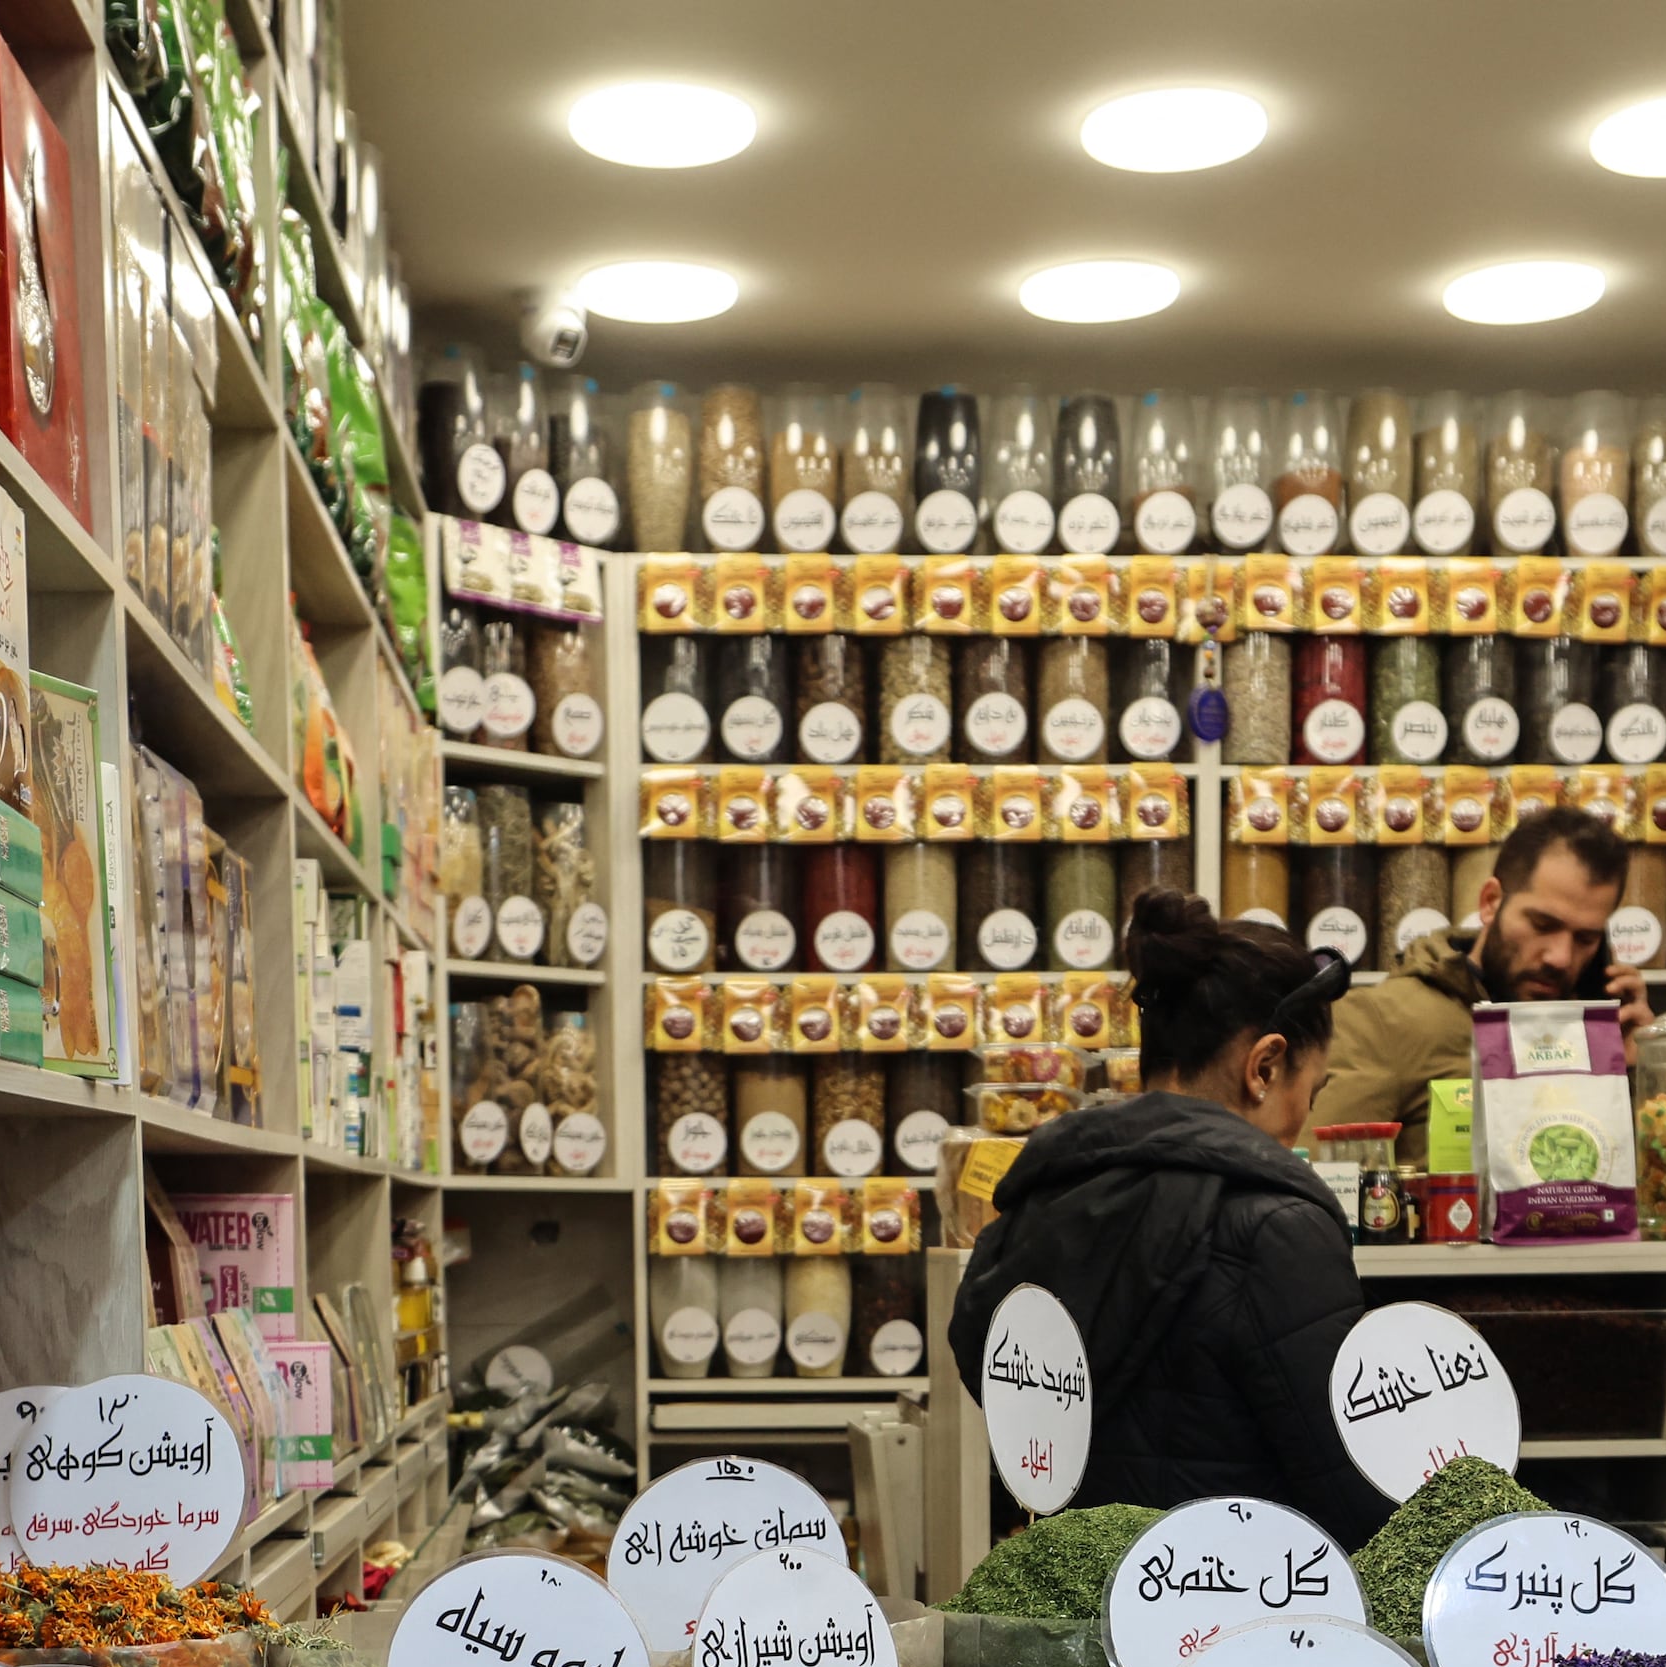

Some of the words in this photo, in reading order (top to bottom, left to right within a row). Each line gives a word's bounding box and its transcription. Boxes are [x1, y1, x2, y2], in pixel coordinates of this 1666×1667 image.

[988, 1327, 1041, 1391] خشک
[1043, 1356, 1086, 1412] شوید
[1426, 1343, 1488, 1393] نعنا
[1343, 1357, 1432, 1424] خشک
[26, 1424, 123, 1482] کوهی
[129, 1417, 214, 1476] آویشن
[625, 1521, 661, 1566] ای
[669, 1520, 748, 1563] خوشه
[755, 1508, 827, 1550] سماق
[1138, 1544, 1249, 1601] ختمی
[1259, 1544, 1329, 1609] گل
[1465, 1542, 1564, 1614] پنیرک
[1571, 1553, 1636, 1615] گل
[435, 1587, 527, 1662] سیاه
[798, 1603, 876, 1667] آویشن
